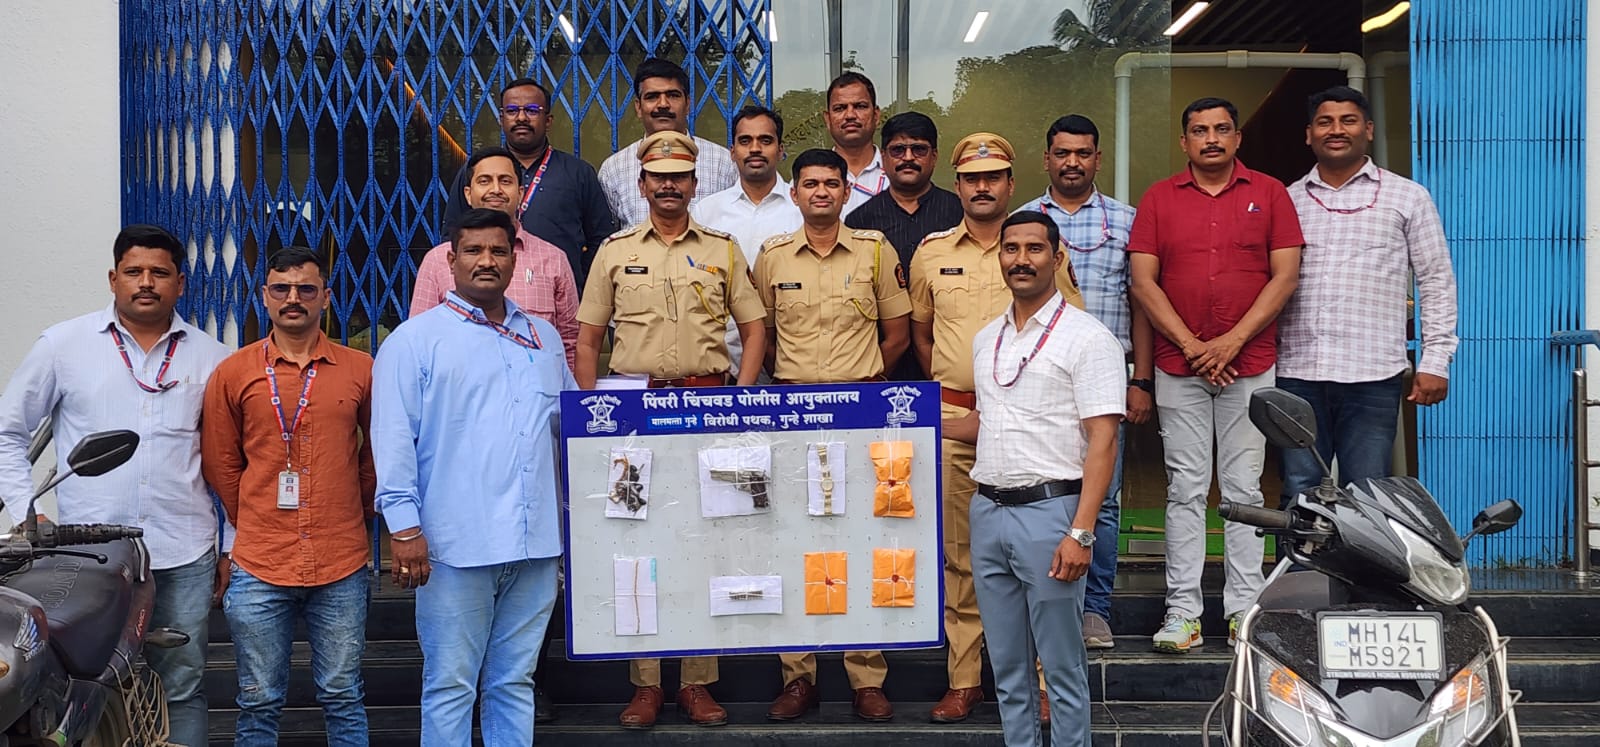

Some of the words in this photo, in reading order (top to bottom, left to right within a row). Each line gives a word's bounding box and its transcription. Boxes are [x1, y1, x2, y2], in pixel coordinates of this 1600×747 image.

[642, 392, 677, 409] पिंपरी
[682, 391, 732, 408] चिंचवड
[736, 389, 780, 406] पोलीस
[786, 391, 860, 409] आयुक्तालय
[702, 412, 739, 427] विरोधी
[742, 414, 776, 427] पथक,
[779, 411, 799, 429] गुन्हे
[802, 412, 834, 425] शाखा
[1347, 622, 1426, 643] MH14L
[1349, 646, 1425, 667] M5921
